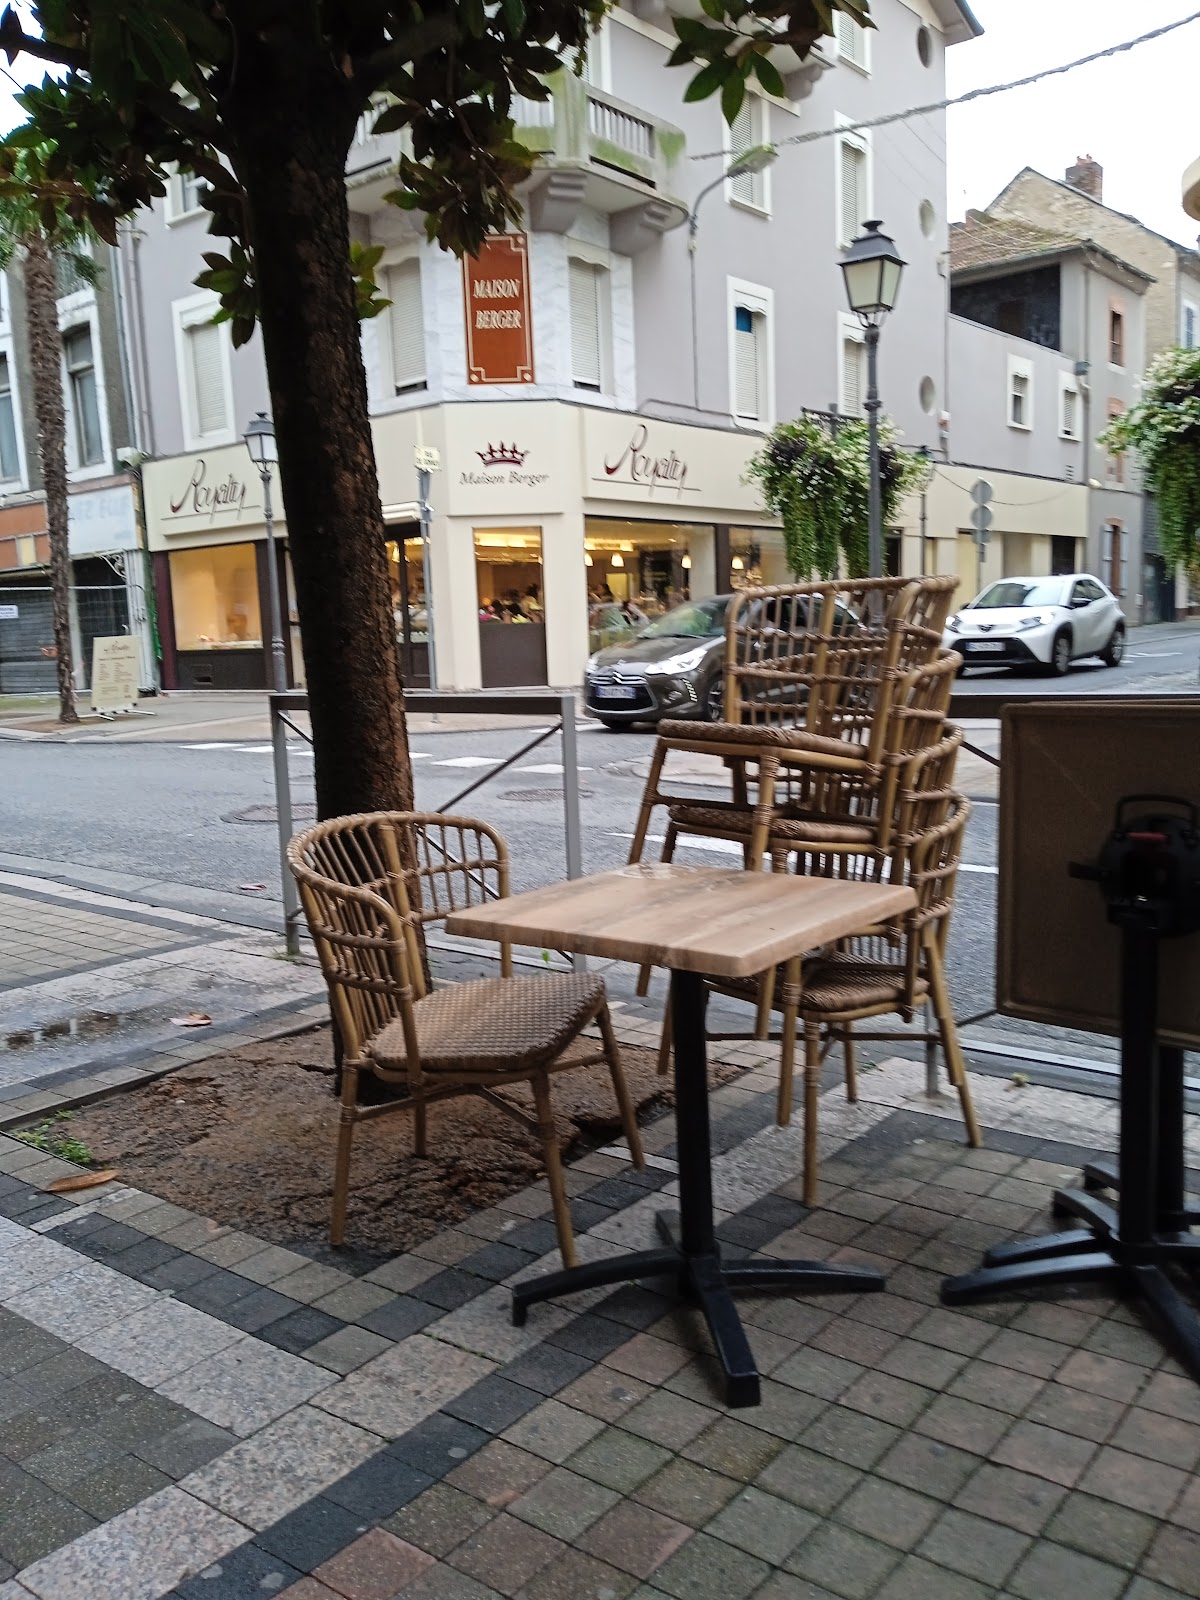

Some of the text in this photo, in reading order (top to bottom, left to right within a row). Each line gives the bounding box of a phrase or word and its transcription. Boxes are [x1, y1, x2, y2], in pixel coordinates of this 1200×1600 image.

[473, 279, 520, 298] MAISON
[475, 310, 522, 329] BERGER
[604, 424, 688, 499] Royalty
[459, 471, 549, 487] Maison Berger
[170, 459, 246, 524] Royalty
